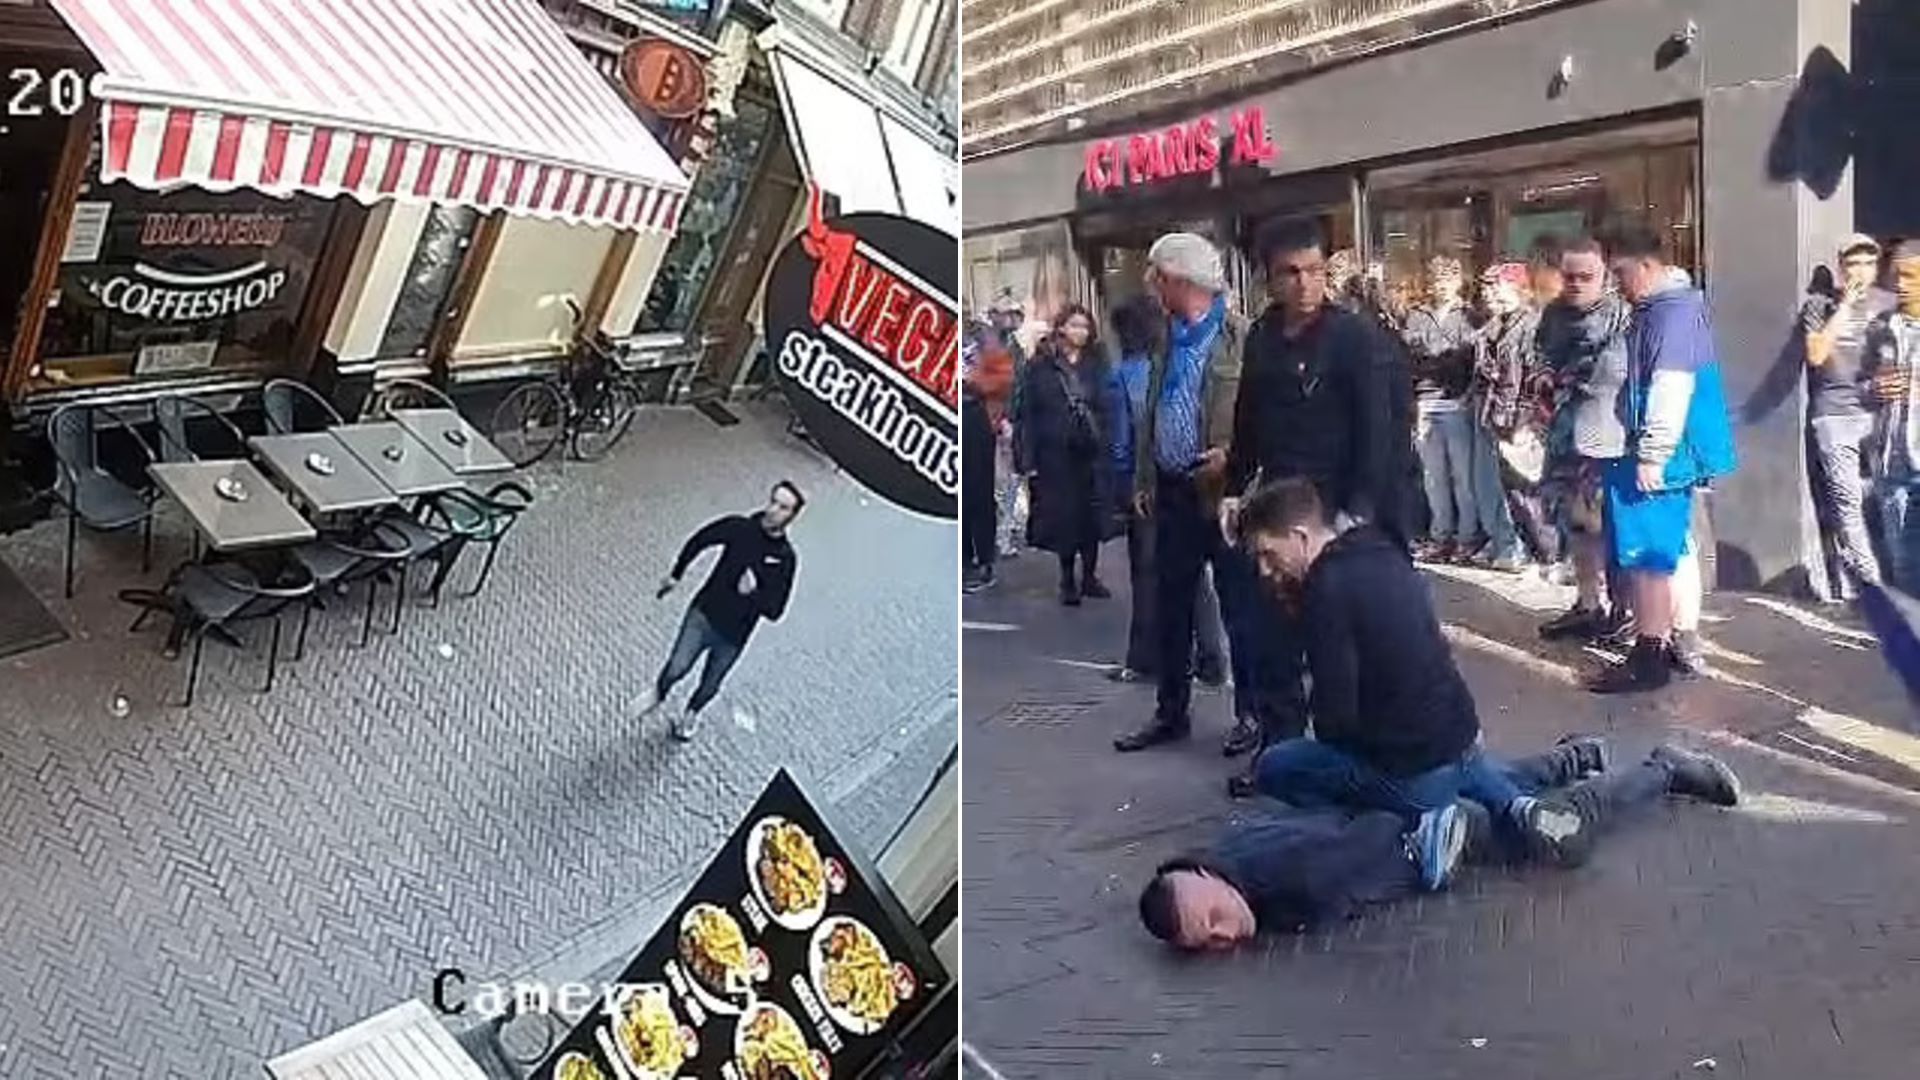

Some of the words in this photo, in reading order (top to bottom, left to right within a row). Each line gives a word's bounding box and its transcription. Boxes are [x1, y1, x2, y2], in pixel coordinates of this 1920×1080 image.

[1128, 116, 1220, 184] PARIS
[1230, 104, 1282, 164] XL
[102, 271, 285, 319] COFFEESHOP
